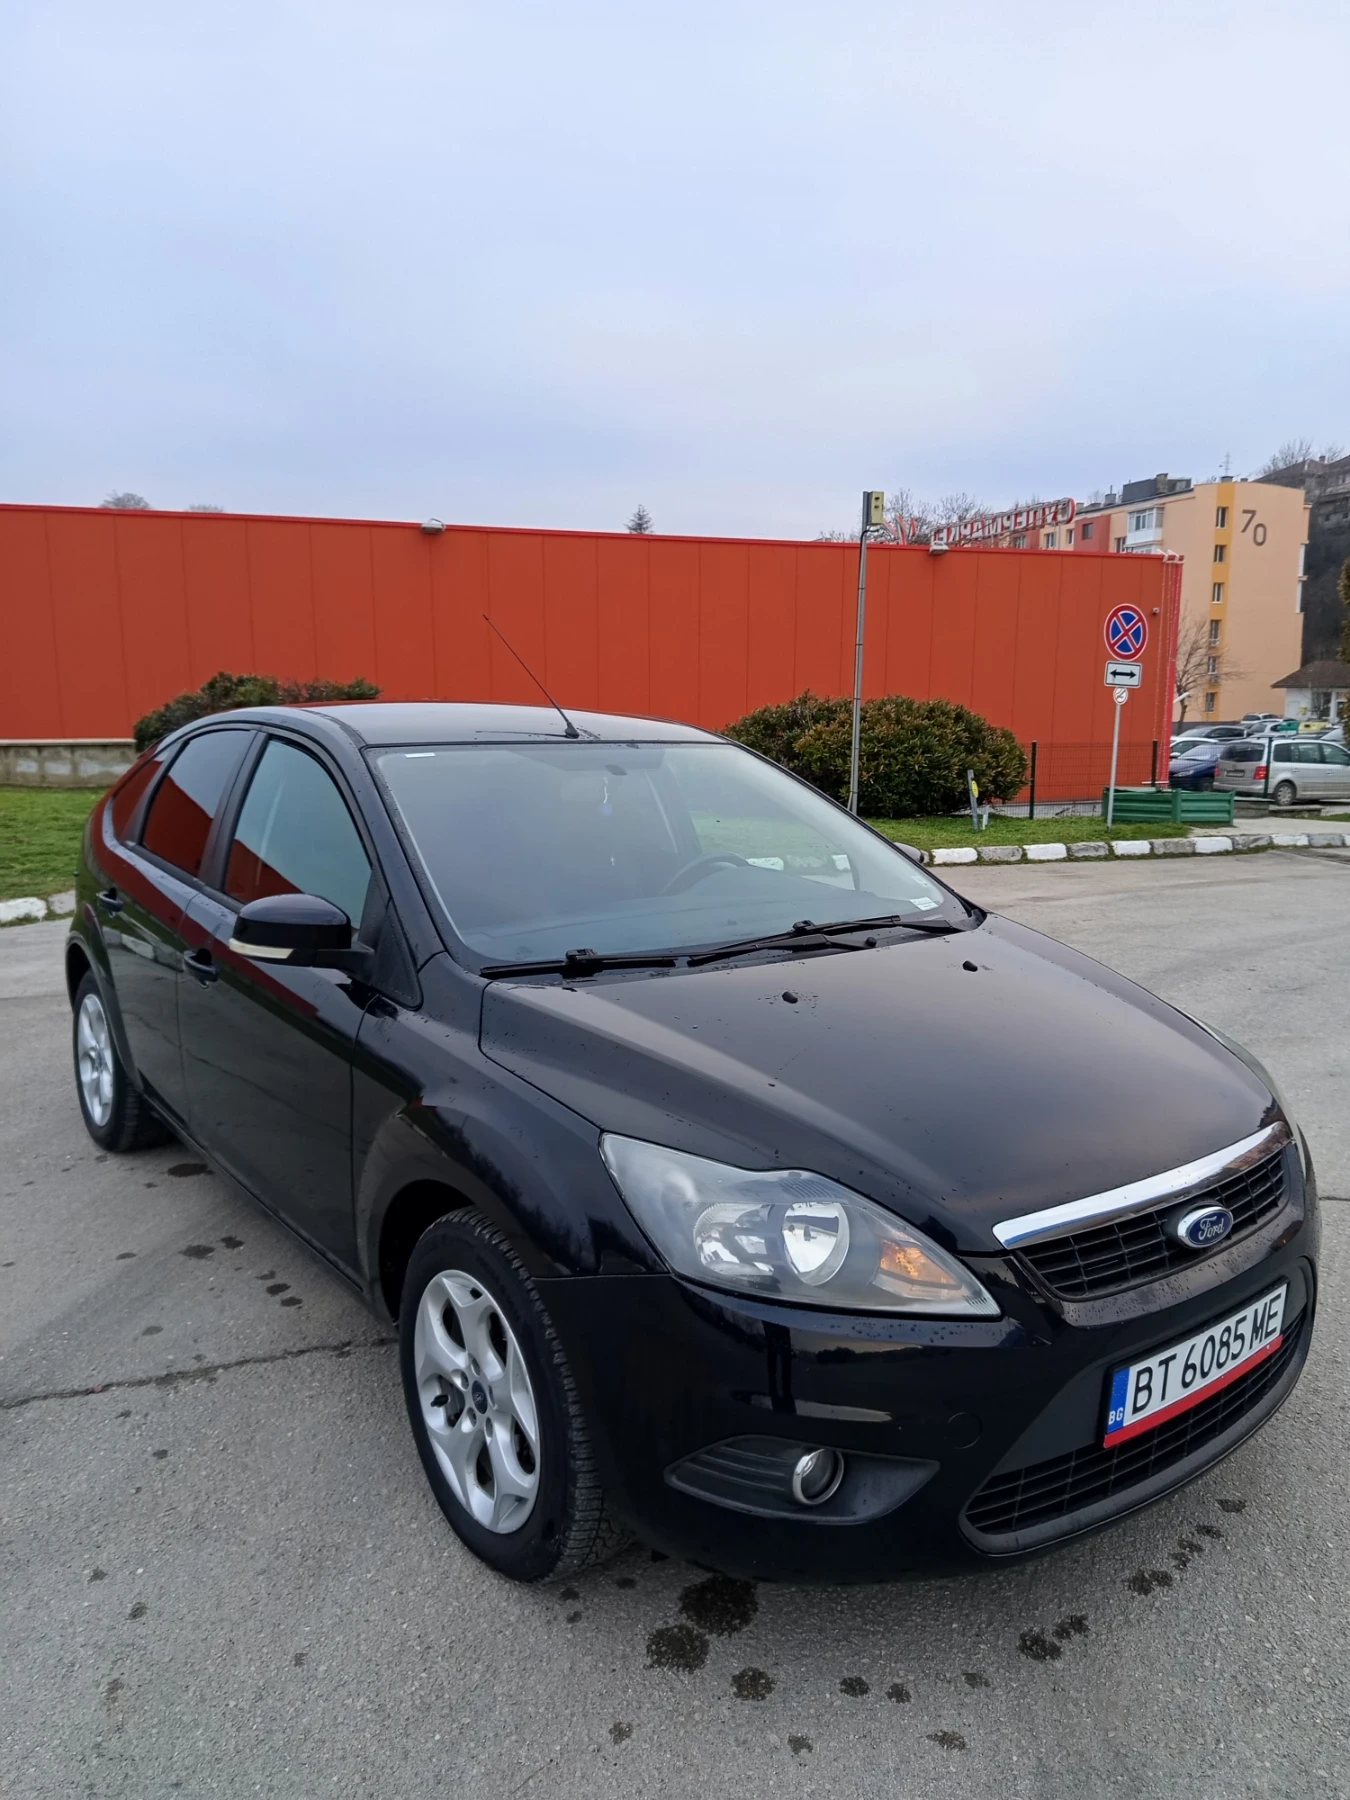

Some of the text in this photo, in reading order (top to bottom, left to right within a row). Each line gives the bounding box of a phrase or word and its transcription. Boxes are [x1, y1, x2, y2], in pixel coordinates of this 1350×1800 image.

[1241, 509, 1267, 546] 70
[1198, 1216, 1225, 1240] Ford
[1108, 1407, 1124, 1426] BG
